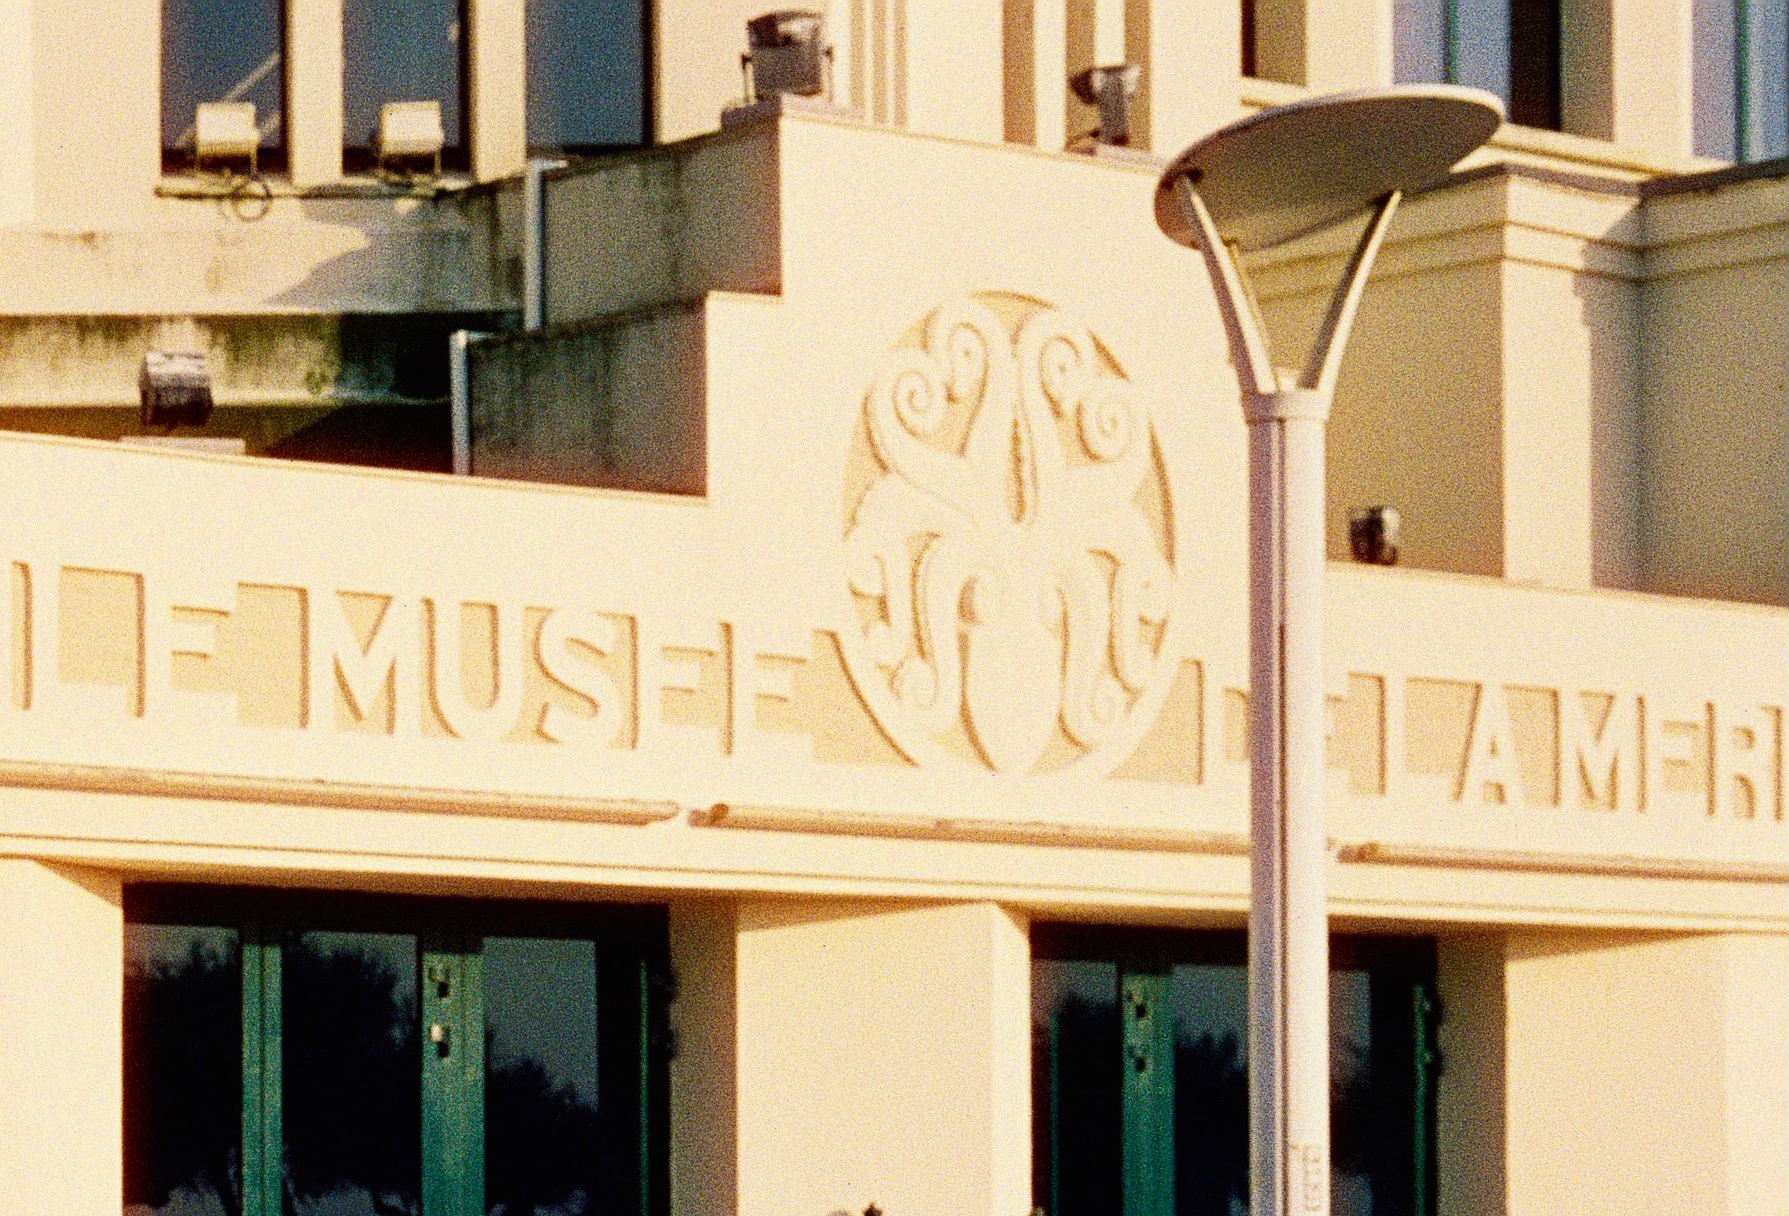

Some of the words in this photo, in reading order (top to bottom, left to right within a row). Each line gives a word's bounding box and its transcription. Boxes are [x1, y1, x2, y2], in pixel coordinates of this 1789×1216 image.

[24, 563, 236, 726] LE
[302, 586, 815, 762] MUSEE
[1379, 676, 1524, 806] LA
[1553, 687, 1774, 820] MER
